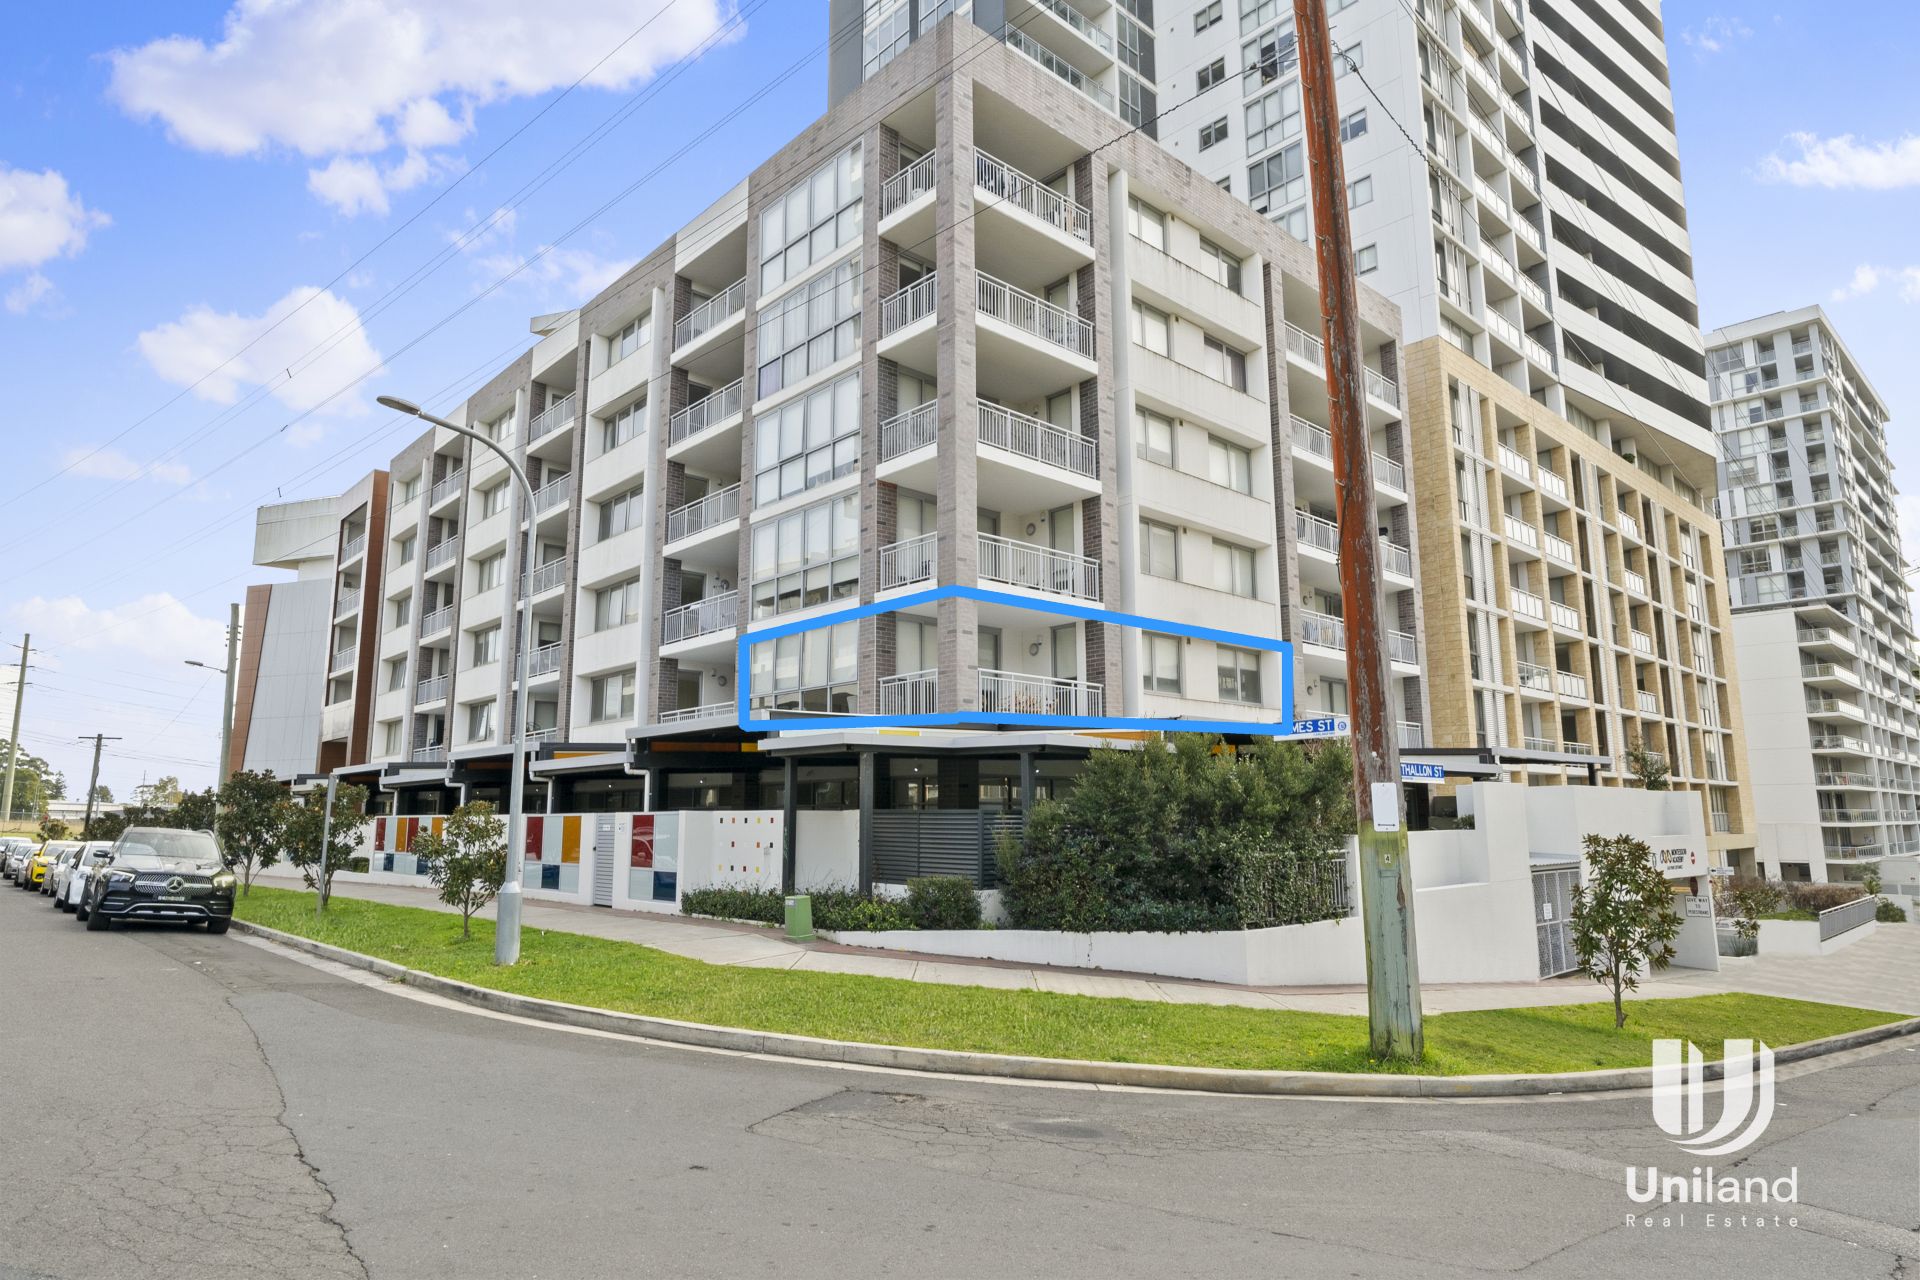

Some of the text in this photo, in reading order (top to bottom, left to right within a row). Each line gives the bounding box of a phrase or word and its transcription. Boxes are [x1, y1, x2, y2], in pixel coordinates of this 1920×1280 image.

[1292, 719, 1332, 733] MES ST
[1401, 763, 1443, 777] THALLON ST
